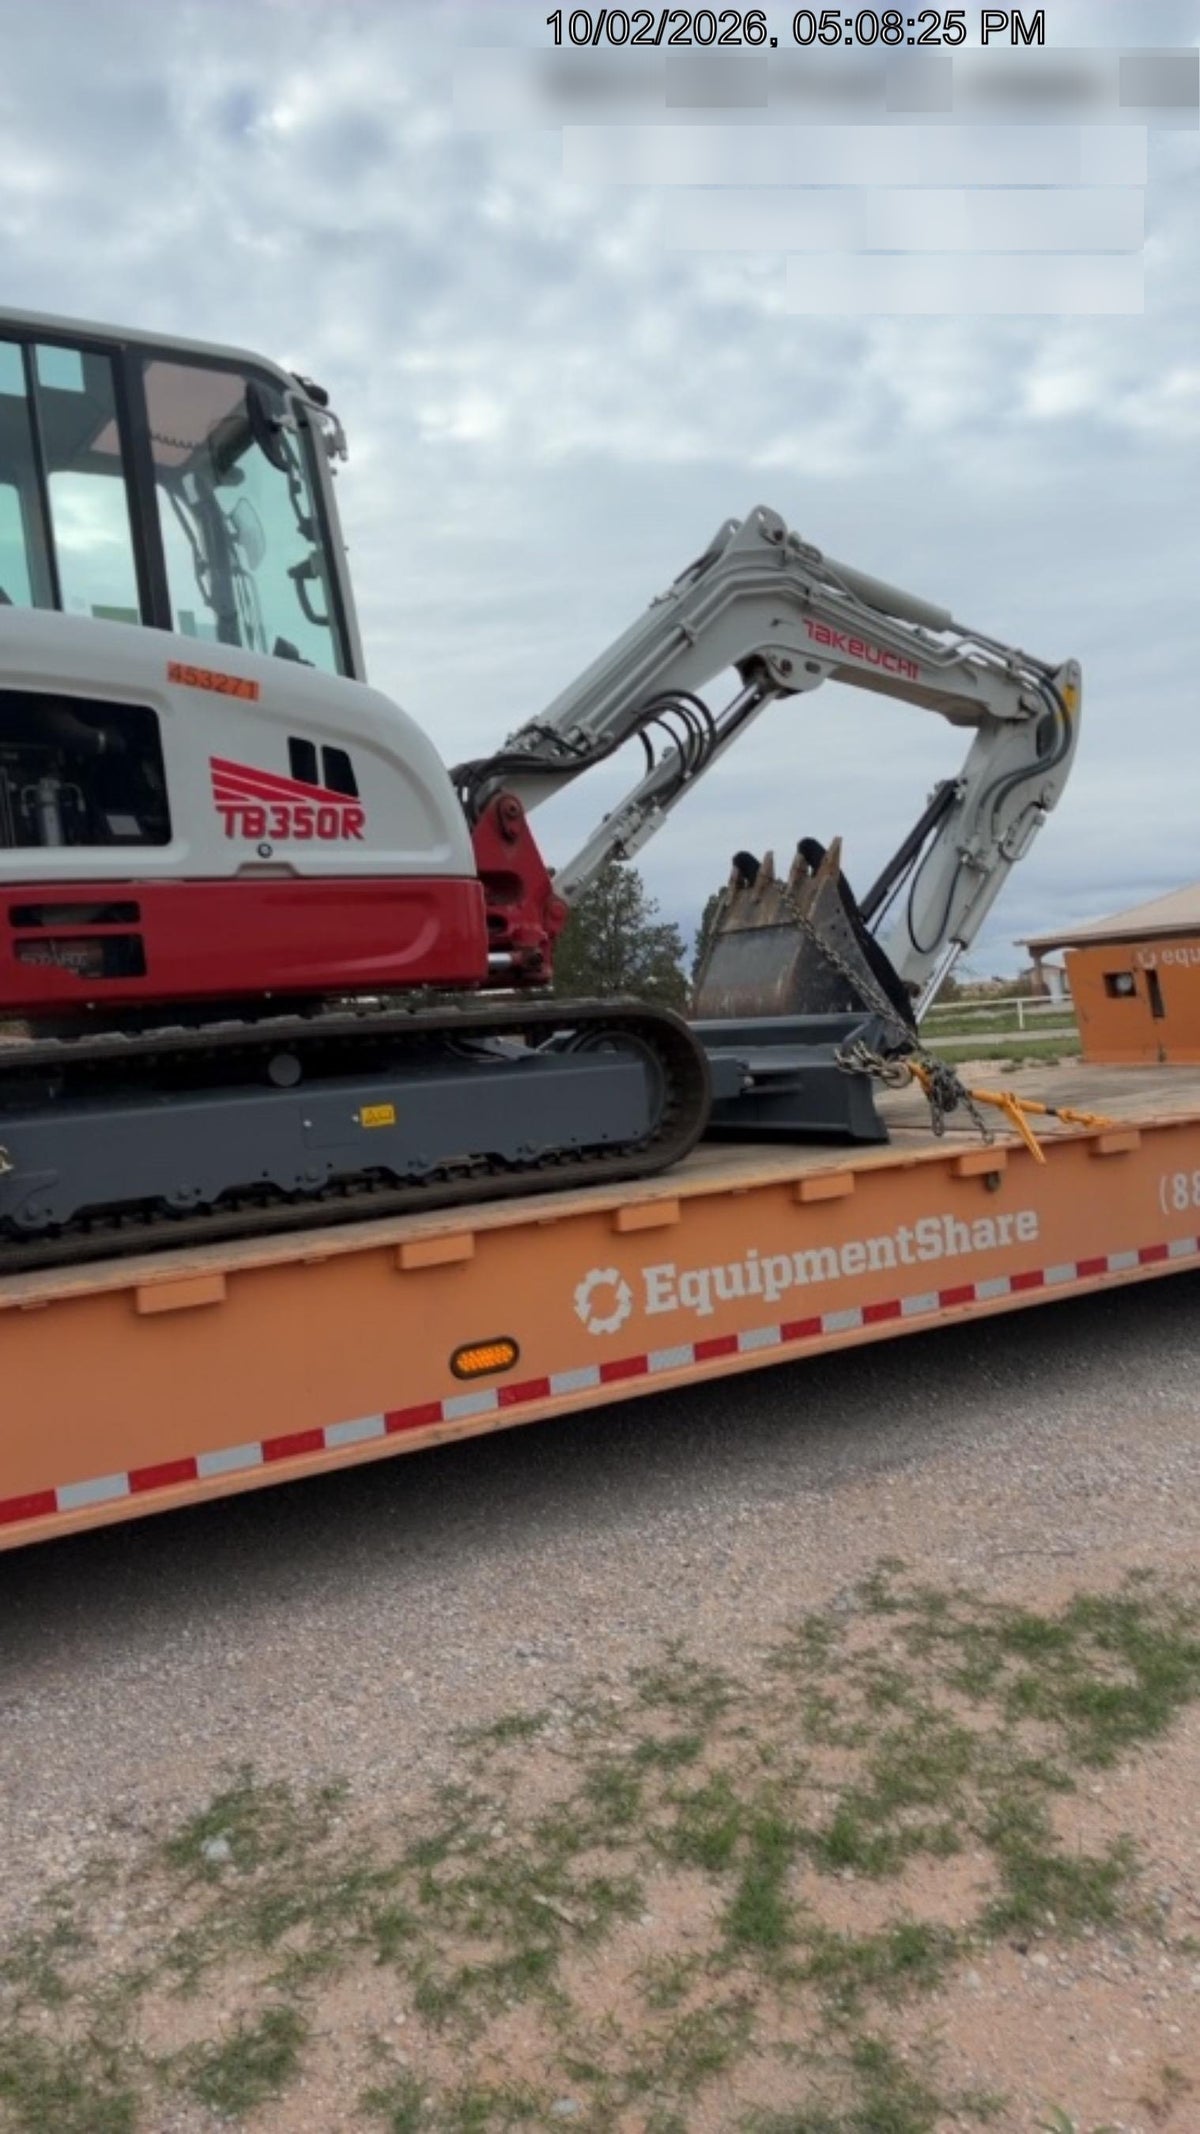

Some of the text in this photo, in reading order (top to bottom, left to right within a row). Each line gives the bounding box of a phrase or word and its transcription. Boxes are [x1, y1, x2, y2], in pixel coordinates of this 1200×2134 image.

[168, 661, 257, 701] 453271
[215, 805, 365, 840] TB350R
[642, 1210, 1039, 1316] EquipmentShare
